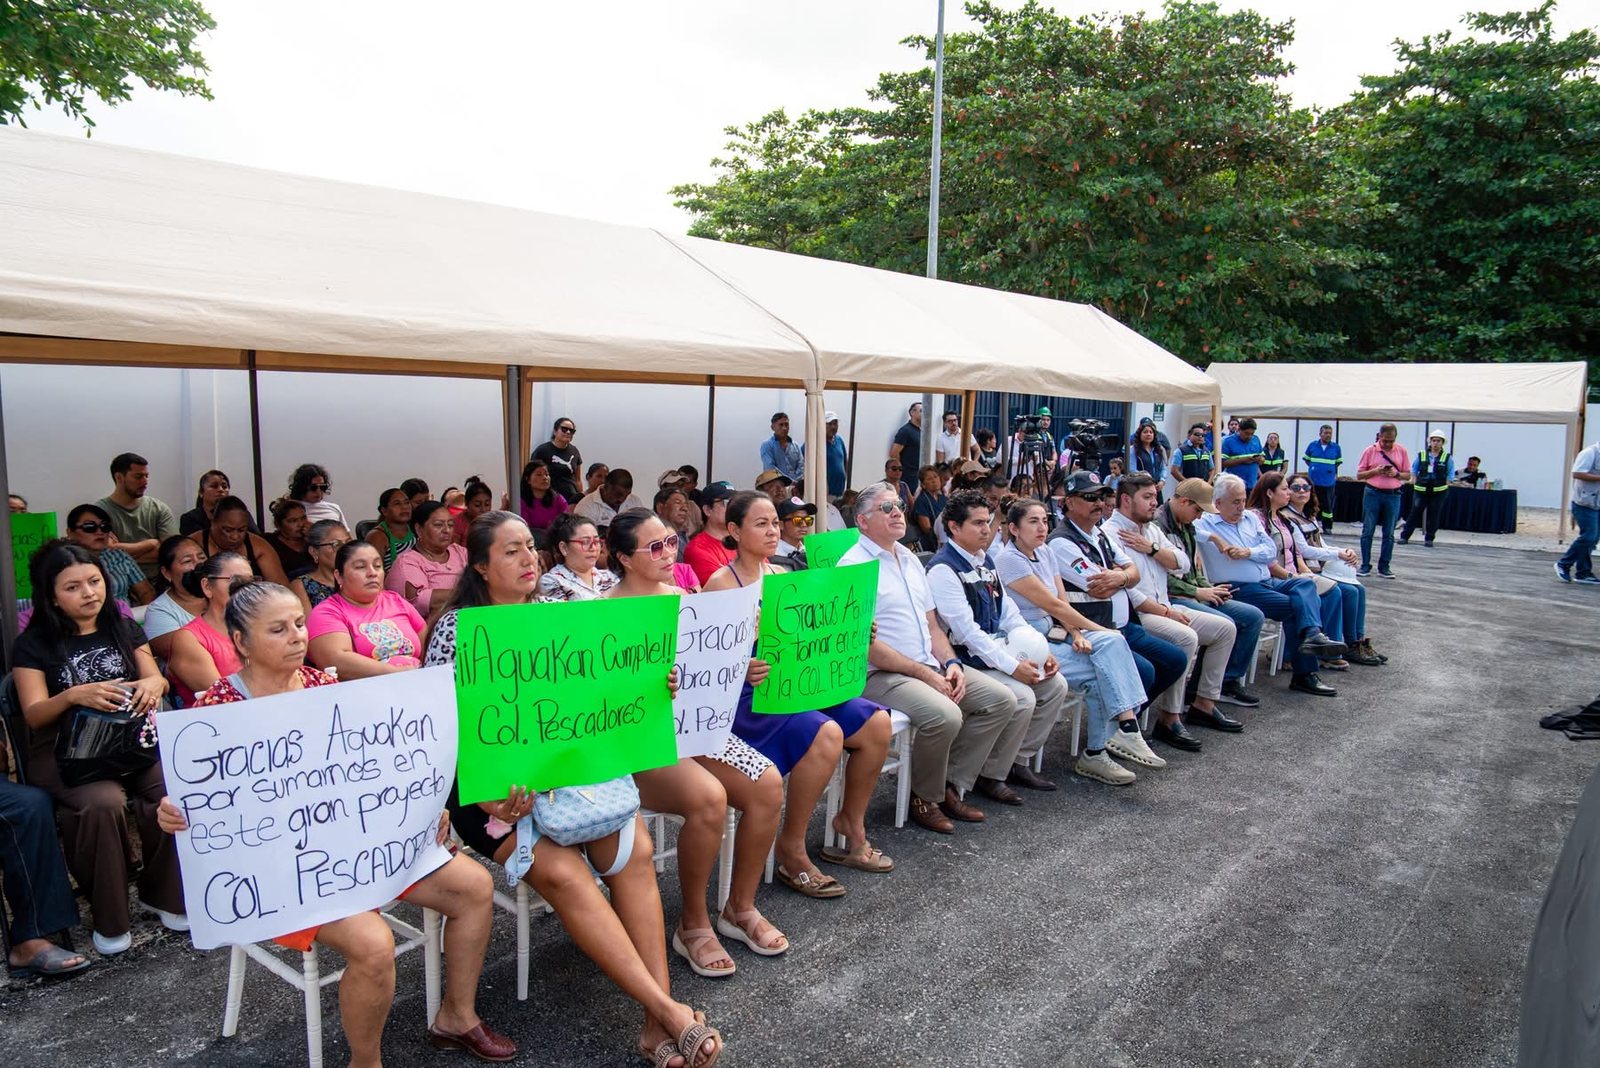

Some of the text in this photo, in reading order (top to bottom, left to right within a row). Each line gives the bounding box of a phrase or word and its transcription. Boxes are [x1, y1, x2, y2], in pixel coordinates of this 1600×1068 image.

[775, 583, 839, 635] Gracias
[791, 633, 832, 662] tomar
[778, 669, 791, 700] la
[798, 666, 827, 696] COL
[477, 696, 646, 746] Col. Pescadores
[695, 704, 735, 733] Pesc
[173, 720, 304, 785] Gracias
[393, 748, 432, 773] en
[190, 767, 445, 855] este gran proyecto
[204, 871, 286, 925] COL.
